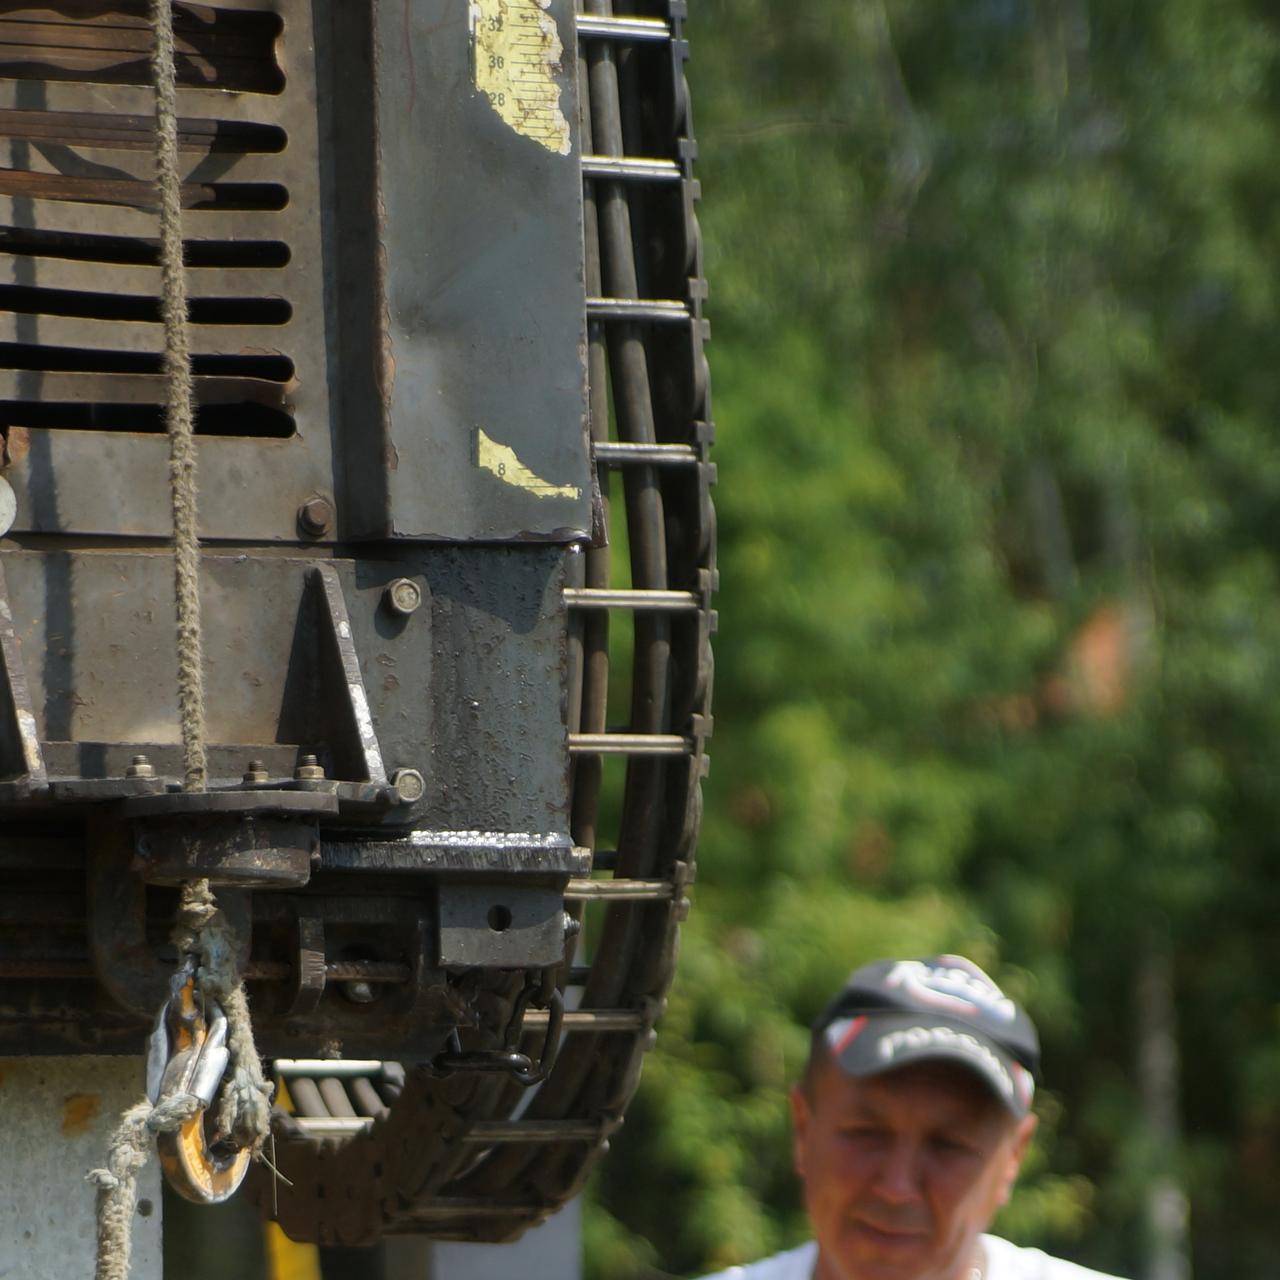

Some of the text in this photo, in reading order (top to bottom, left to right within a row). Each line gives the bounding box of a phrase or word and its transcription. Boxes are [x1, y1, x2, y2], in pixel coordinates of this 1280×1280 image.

[487, 16, 504, 32] 32
[488, 56, 504, 69] 30
[488, 92, 505, 106] 28
[498, 462, 506, 476] 8
